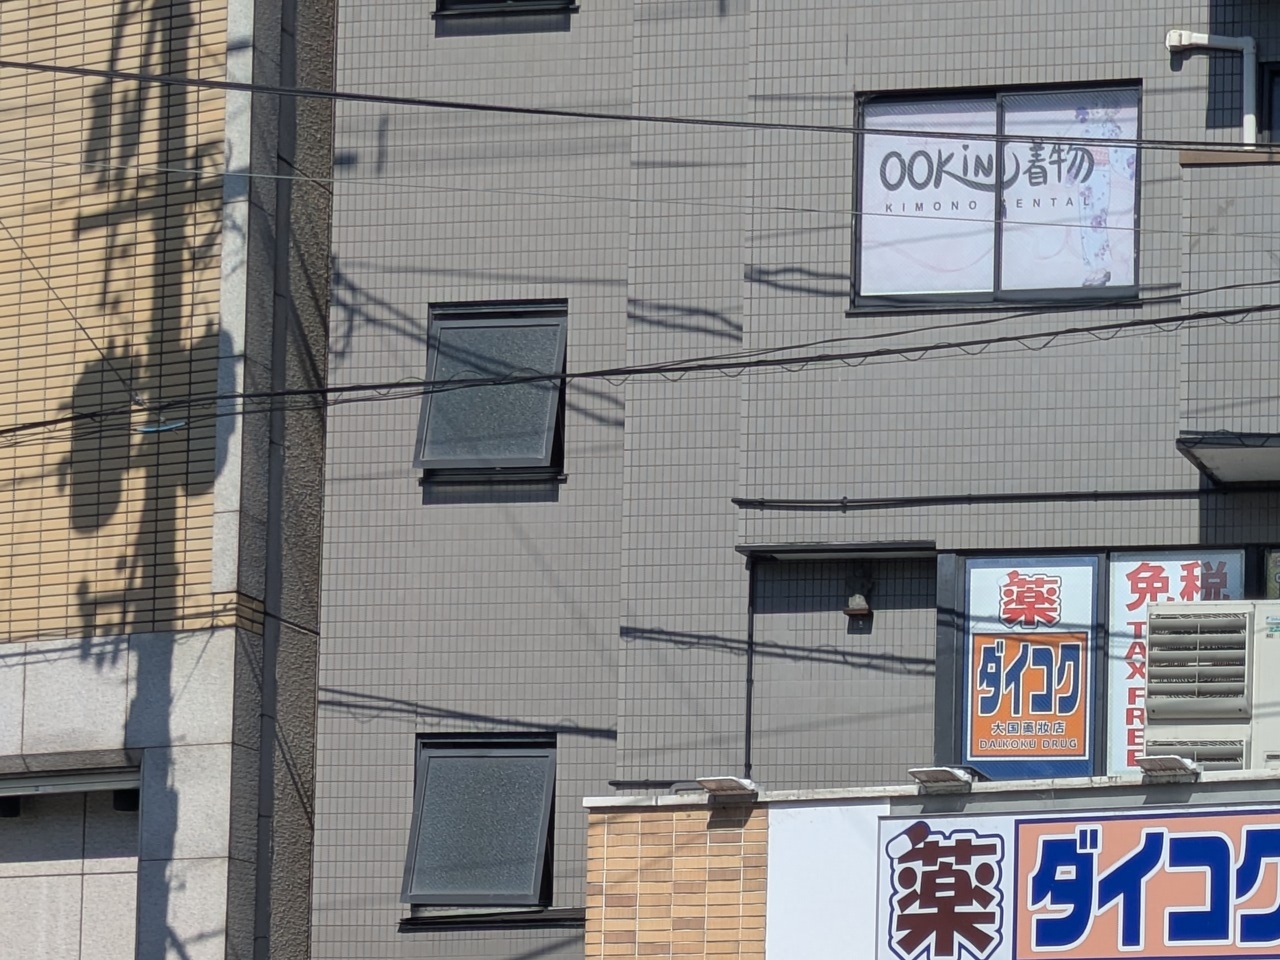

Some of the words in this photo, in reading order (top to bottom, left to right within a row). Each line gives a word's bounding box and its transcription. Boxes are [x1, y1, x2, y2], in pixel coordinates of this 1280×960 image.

[1023, 139, 1095, 188] 着物
[885, 200, 977, 213] KIMONO
[1001, 196, 1091, 210] ENTAL
[1000, 570, 1061, 628] 薬
[1125, 561, 1231, 612] 免税
[977, 640, 1082, 717] ダイコク
[979, 739, 1038, 750] DAIKOKU
[1042, 738, 1078, 749] DRUG
